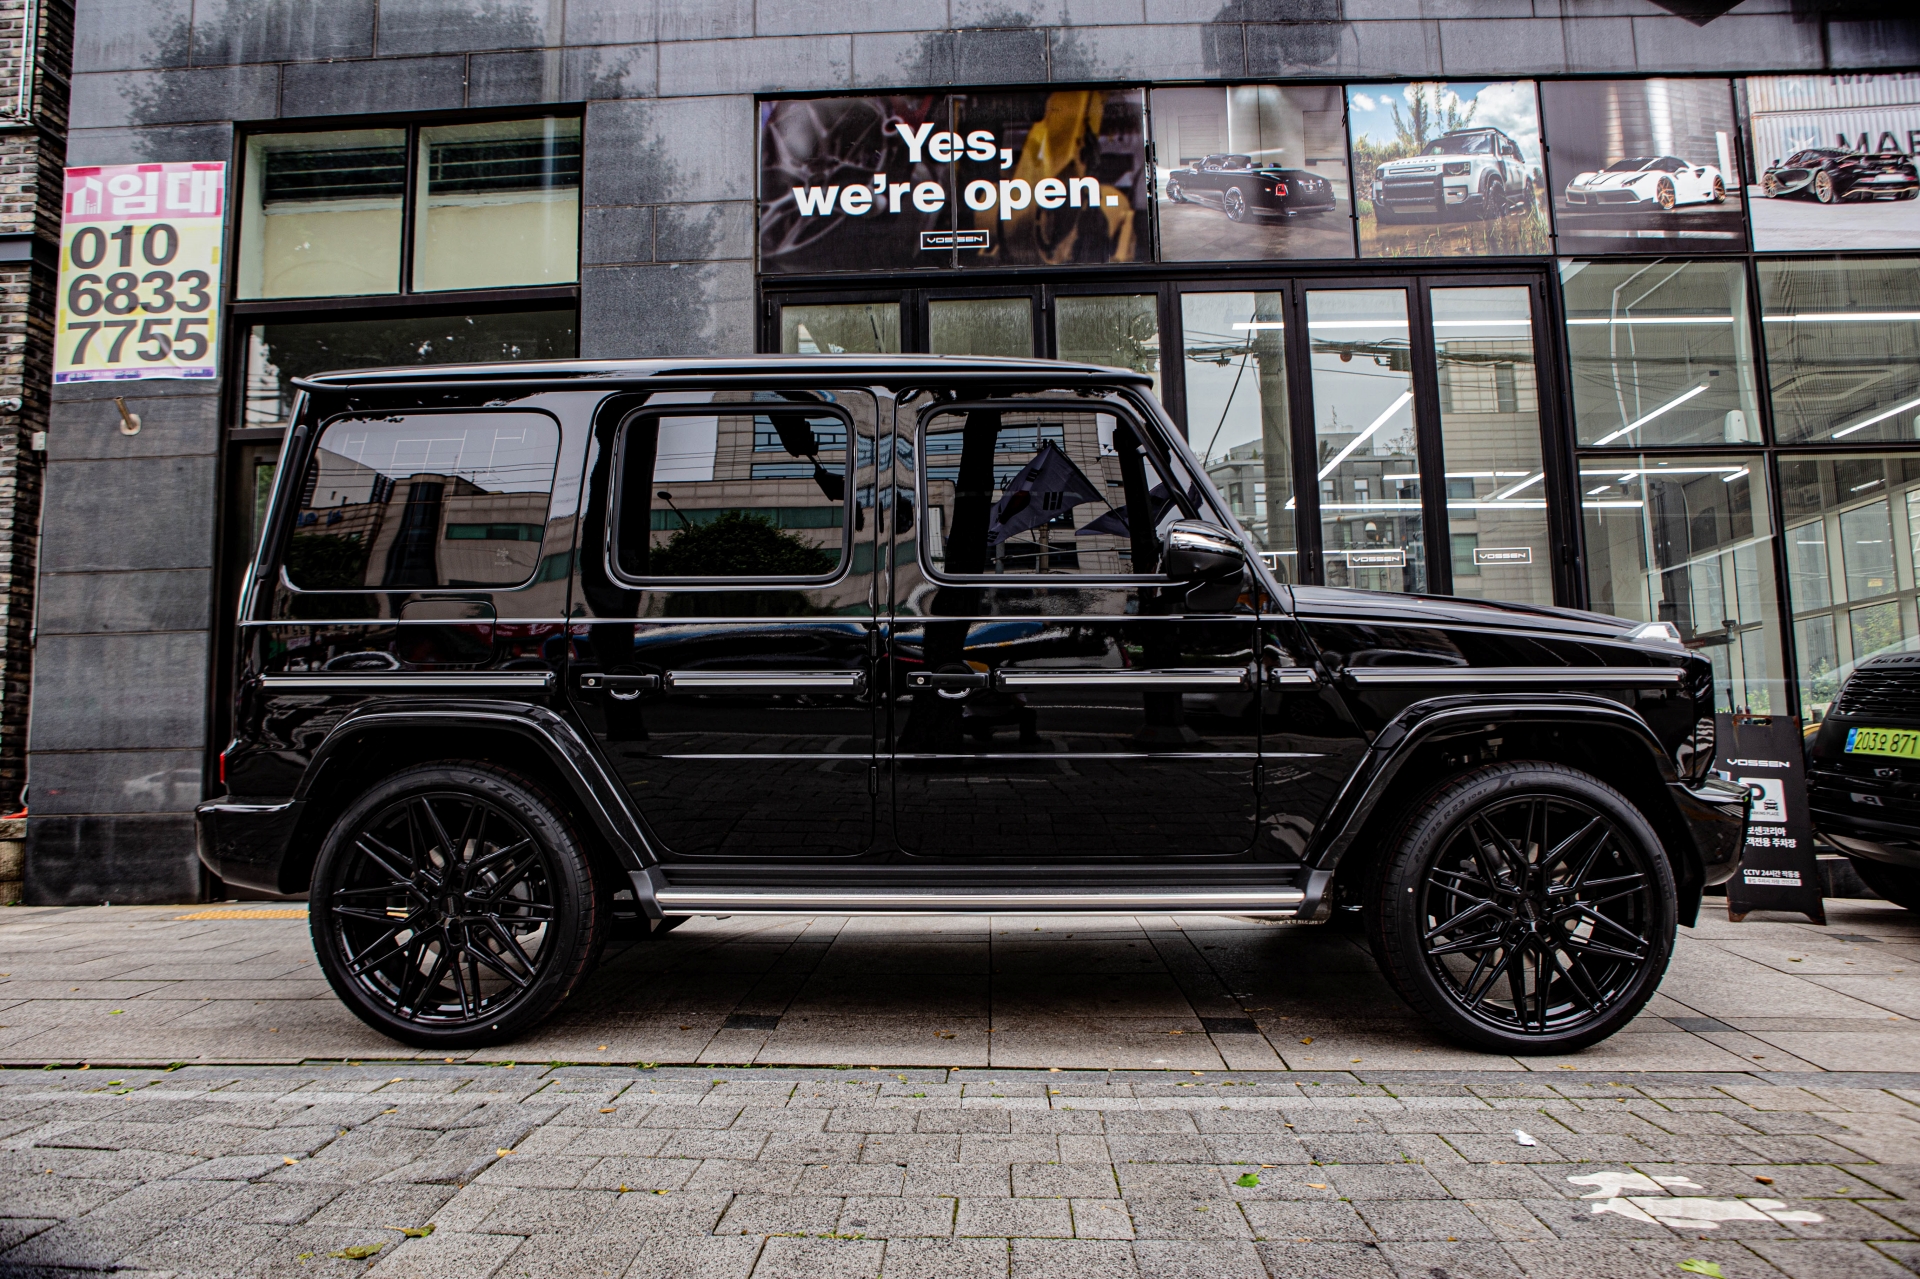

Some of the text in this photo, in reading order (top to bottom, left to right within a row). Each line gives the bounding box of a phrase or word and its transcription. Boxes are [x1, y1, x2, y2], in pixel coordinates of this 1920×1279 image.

[895, 122, 1013, 169] Yes,
[107, 170, 220, 215] 임대
[964, 176, 1119, 220] open.
[71, 223, 178, 269] 010
[926, 235, 983, 243] VOSSEN
[68, 270, 210, 316] 6833
[67, 318, 208, 365] 7755
[1353, 555, 1400, 563] VOSSEN
[1854, 732, 1887, 750] 203오
[1727, 759, 1791, 768] VOSSEN
[467, 776, 548, 828] P ZERO
[1443, 798, 1467, 820] R23
[1745, 837, 1797, 848] 객전용 주차장
